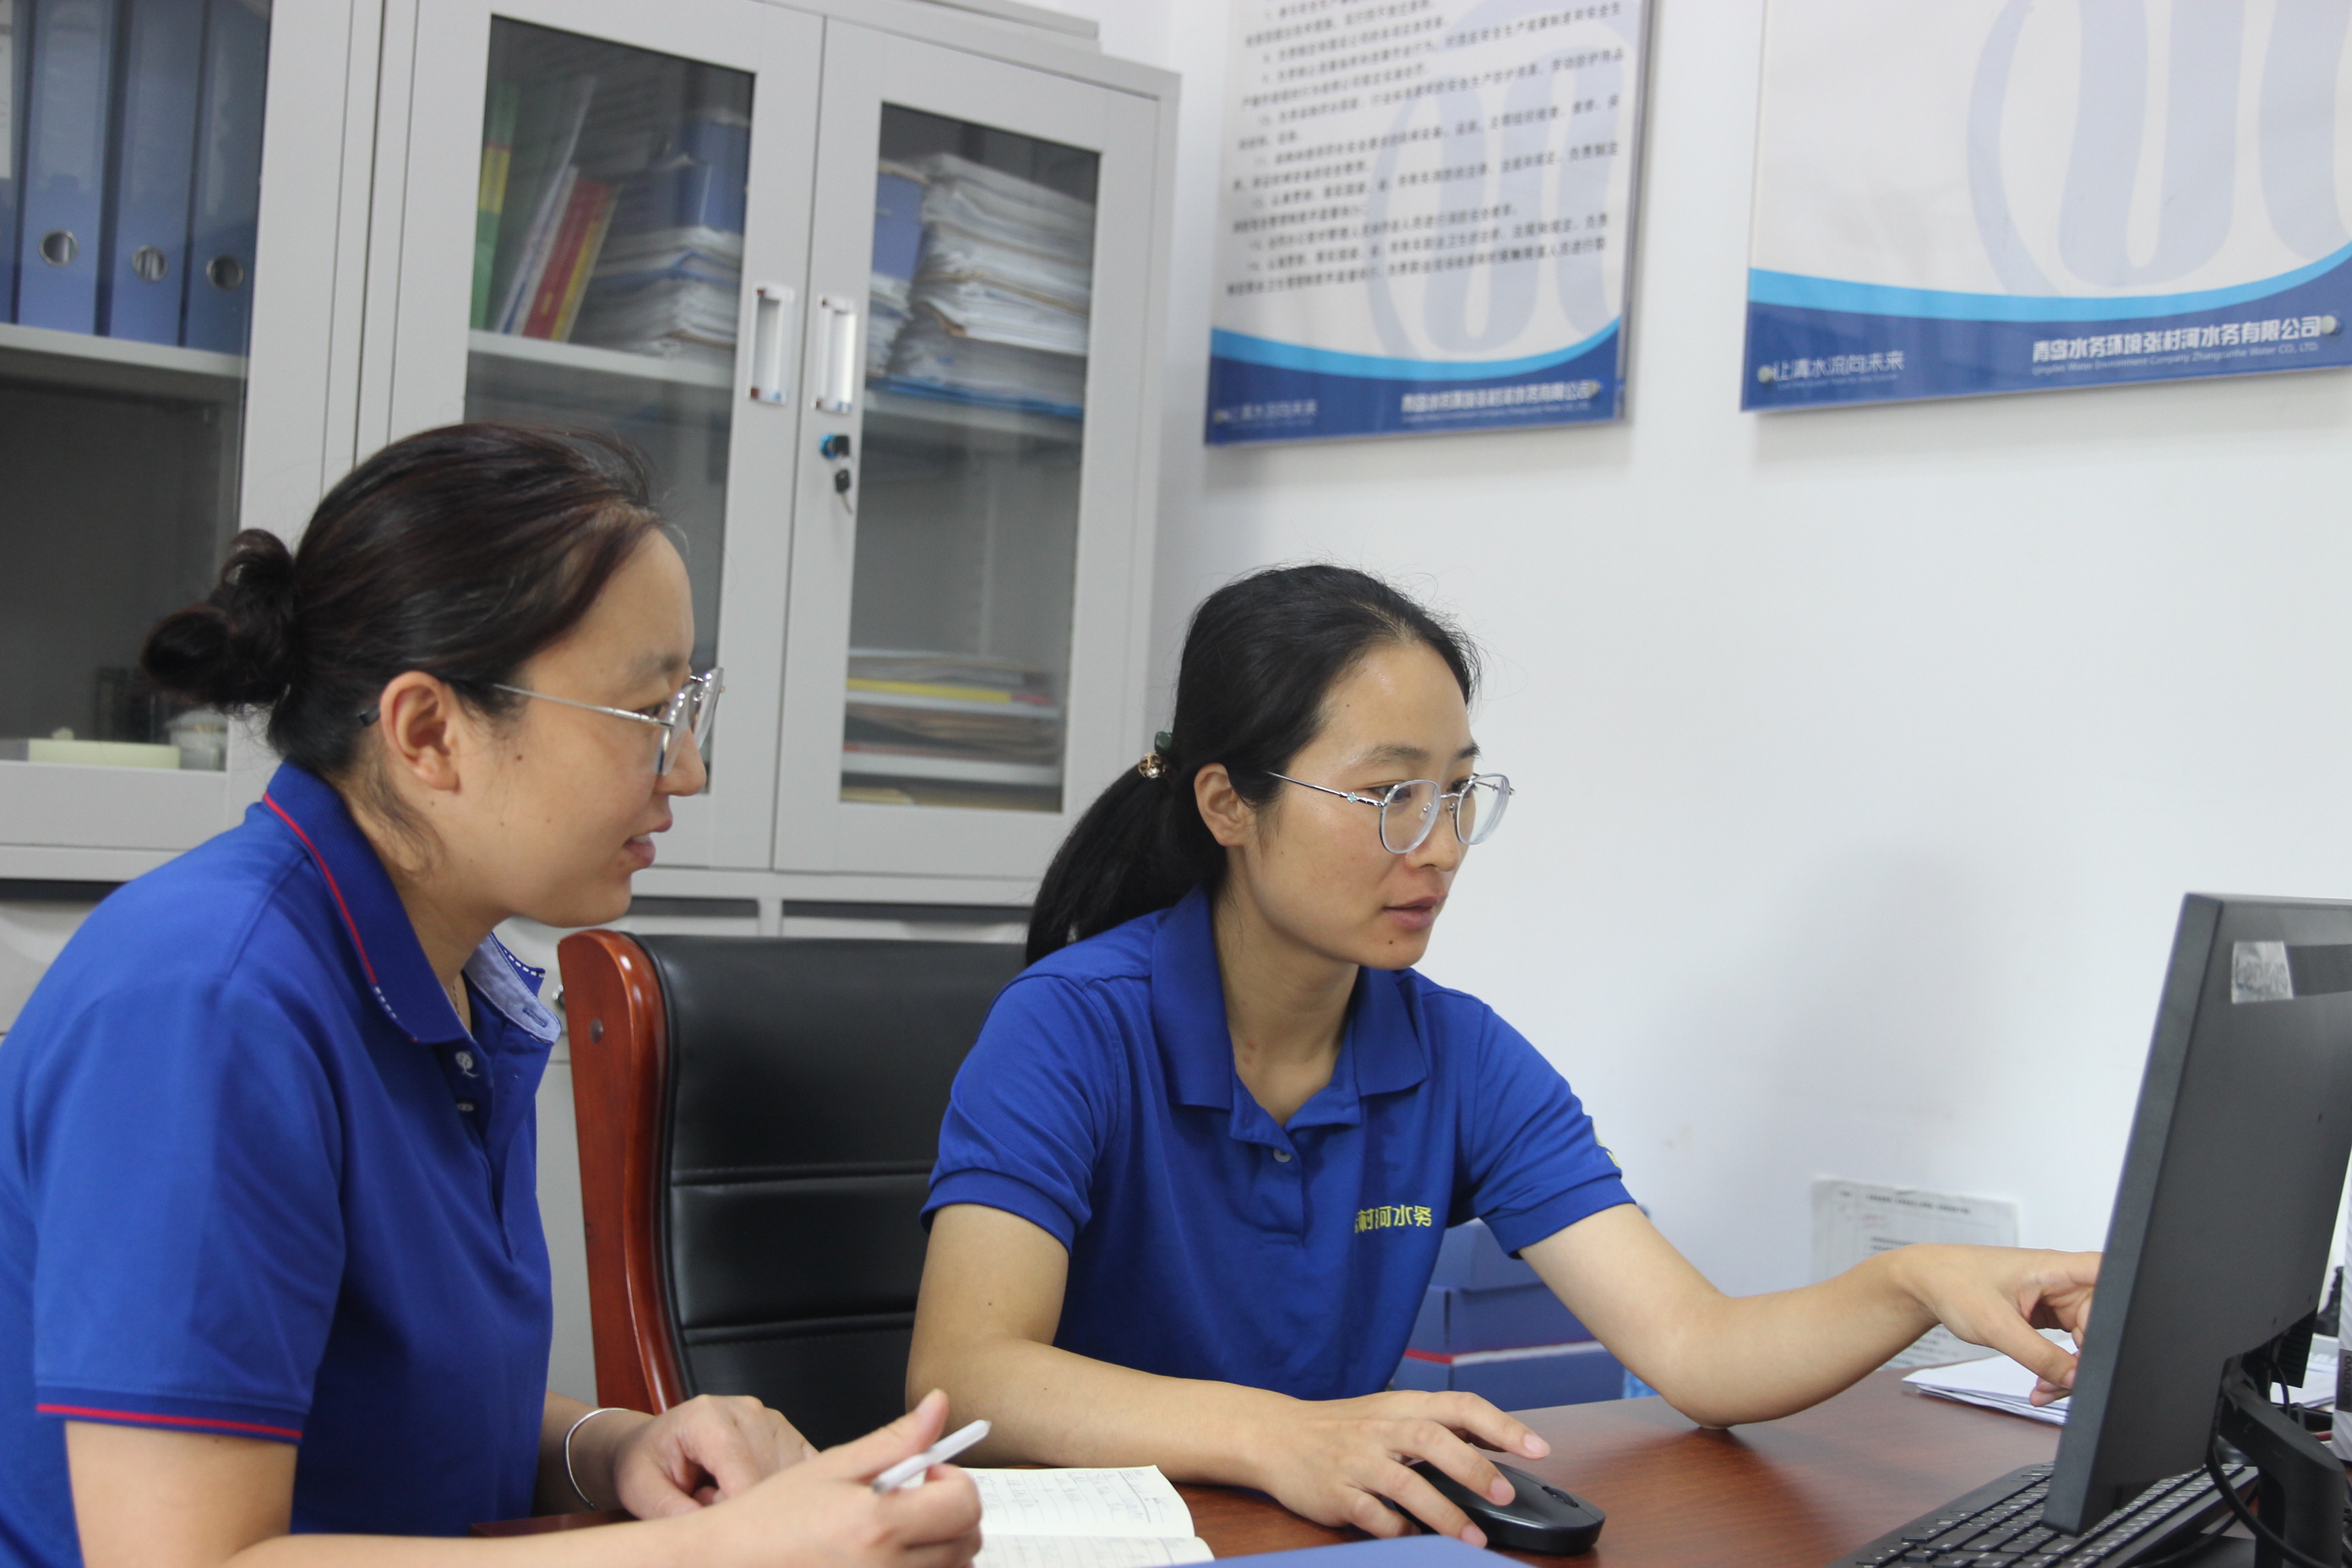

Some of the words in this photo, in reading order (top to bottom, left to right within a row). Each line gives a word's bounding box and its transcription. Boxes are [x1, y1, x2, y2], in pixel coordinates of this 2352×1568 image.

[2032, 315, 2322, 362] 青岛水务环境张村河水务有限公司
[1354, 1204, 1433, 1233] 村河水务
